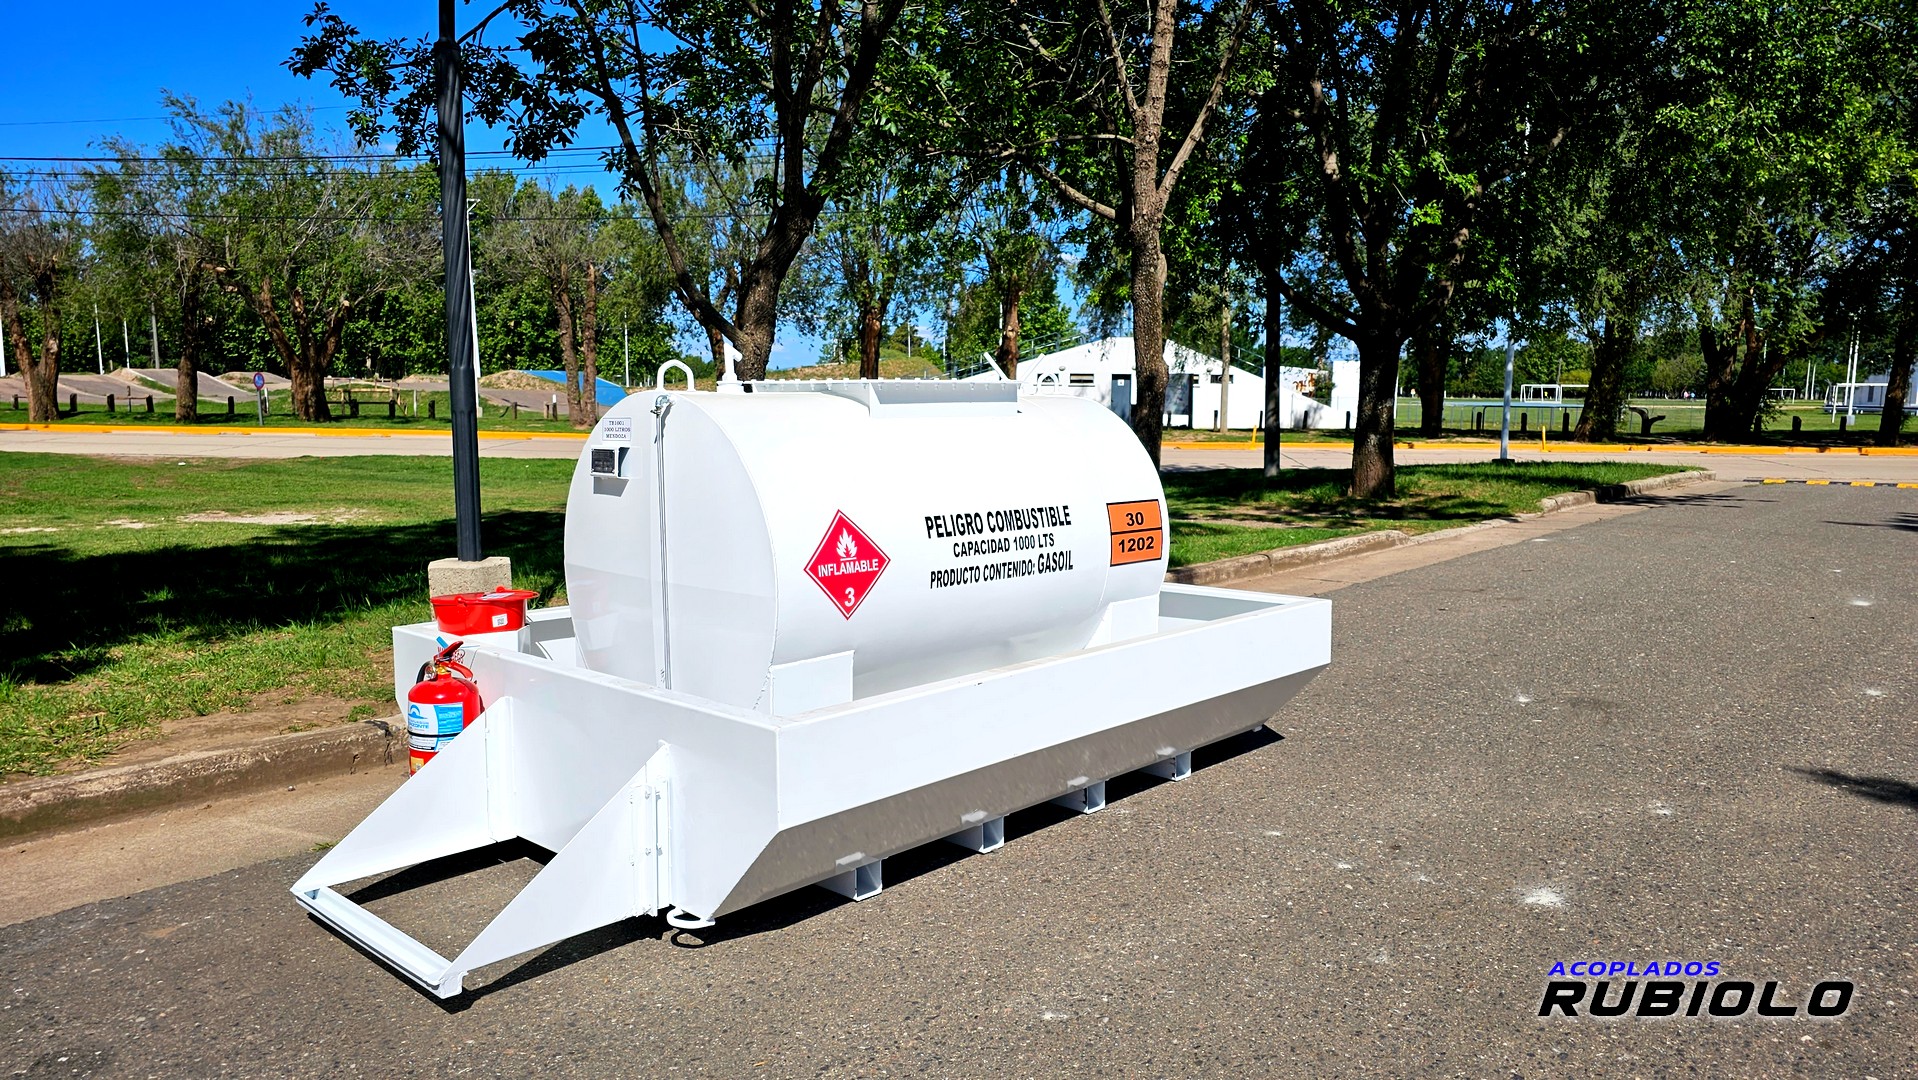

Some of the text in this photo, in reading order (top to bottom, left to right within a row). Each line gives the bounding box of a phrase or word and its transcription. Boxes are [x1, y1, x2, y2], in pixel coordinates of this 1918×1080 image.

[925, 505, 1072, 539] PELIGRO COMBUSTIBLE
[1126, 511, 1144, 526] 30
[953, 532, 1055, 558] CAPACIDAD 1000 LTS
[1118, 535, 1154, 553] 1202
[818, 558, 879, 577] INFLAMABLE
[930, 550, 1073, 589] PRODUCTO CONTENIDO: GASOIL
[844, 587, 855, 607] 3
